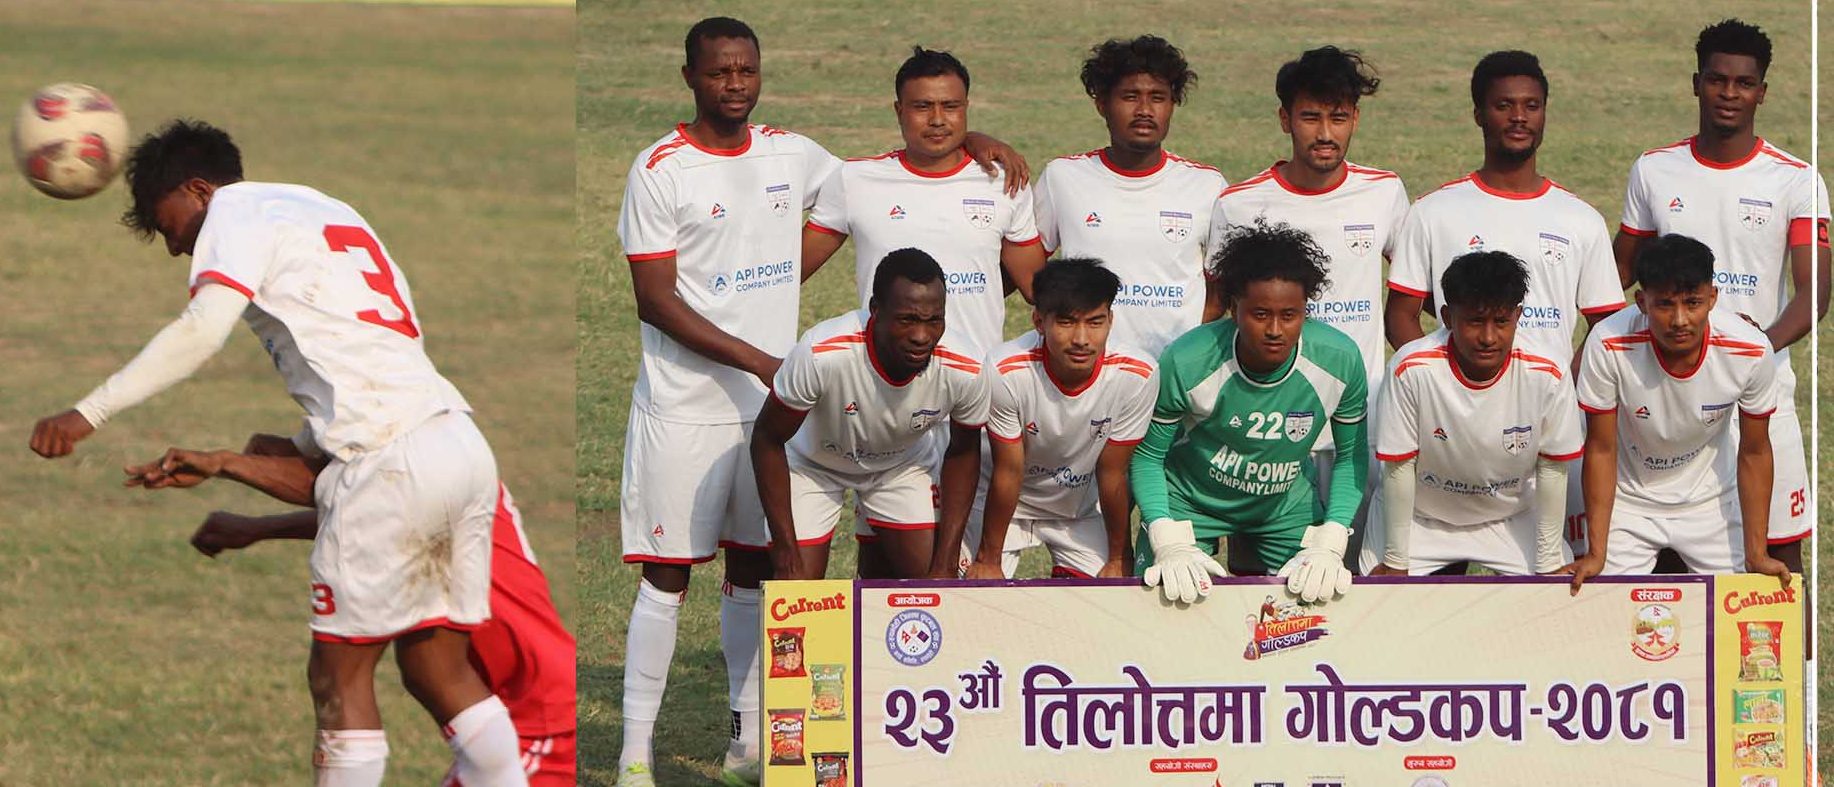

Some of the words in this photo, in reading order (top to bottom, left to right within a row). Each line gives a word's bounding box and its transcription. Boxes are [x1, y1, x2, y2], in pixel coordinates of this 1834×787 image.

[323, 225, 420, 339] 3
[735, 269, 755, 282] API
[758, 260, 793, 278] POWER
[736, 280, 771, 292] COMPANY
[772, 275, 794, 287] LIMITED
[1132, 285, 1184, 298] POWER
[1112, 298, 1149, 307] OMPANY
[1151, 299, 1182, 308] LIMITED
[1324, 300, 1371, 313] POWER
[1522, 306, 1561, 319] OWER
[1246, 411, 1284, 440] 22
[1209, 444, 1244, 477] API
[1244, 460, 1301, 482] POWE
[1790, 488, 1805, 517] 25
[312, 583, 336, 616] 3
[894, 594, 934, 605] आयोजक
[1022, 665, 1266, 750] तिलोत्तमा
